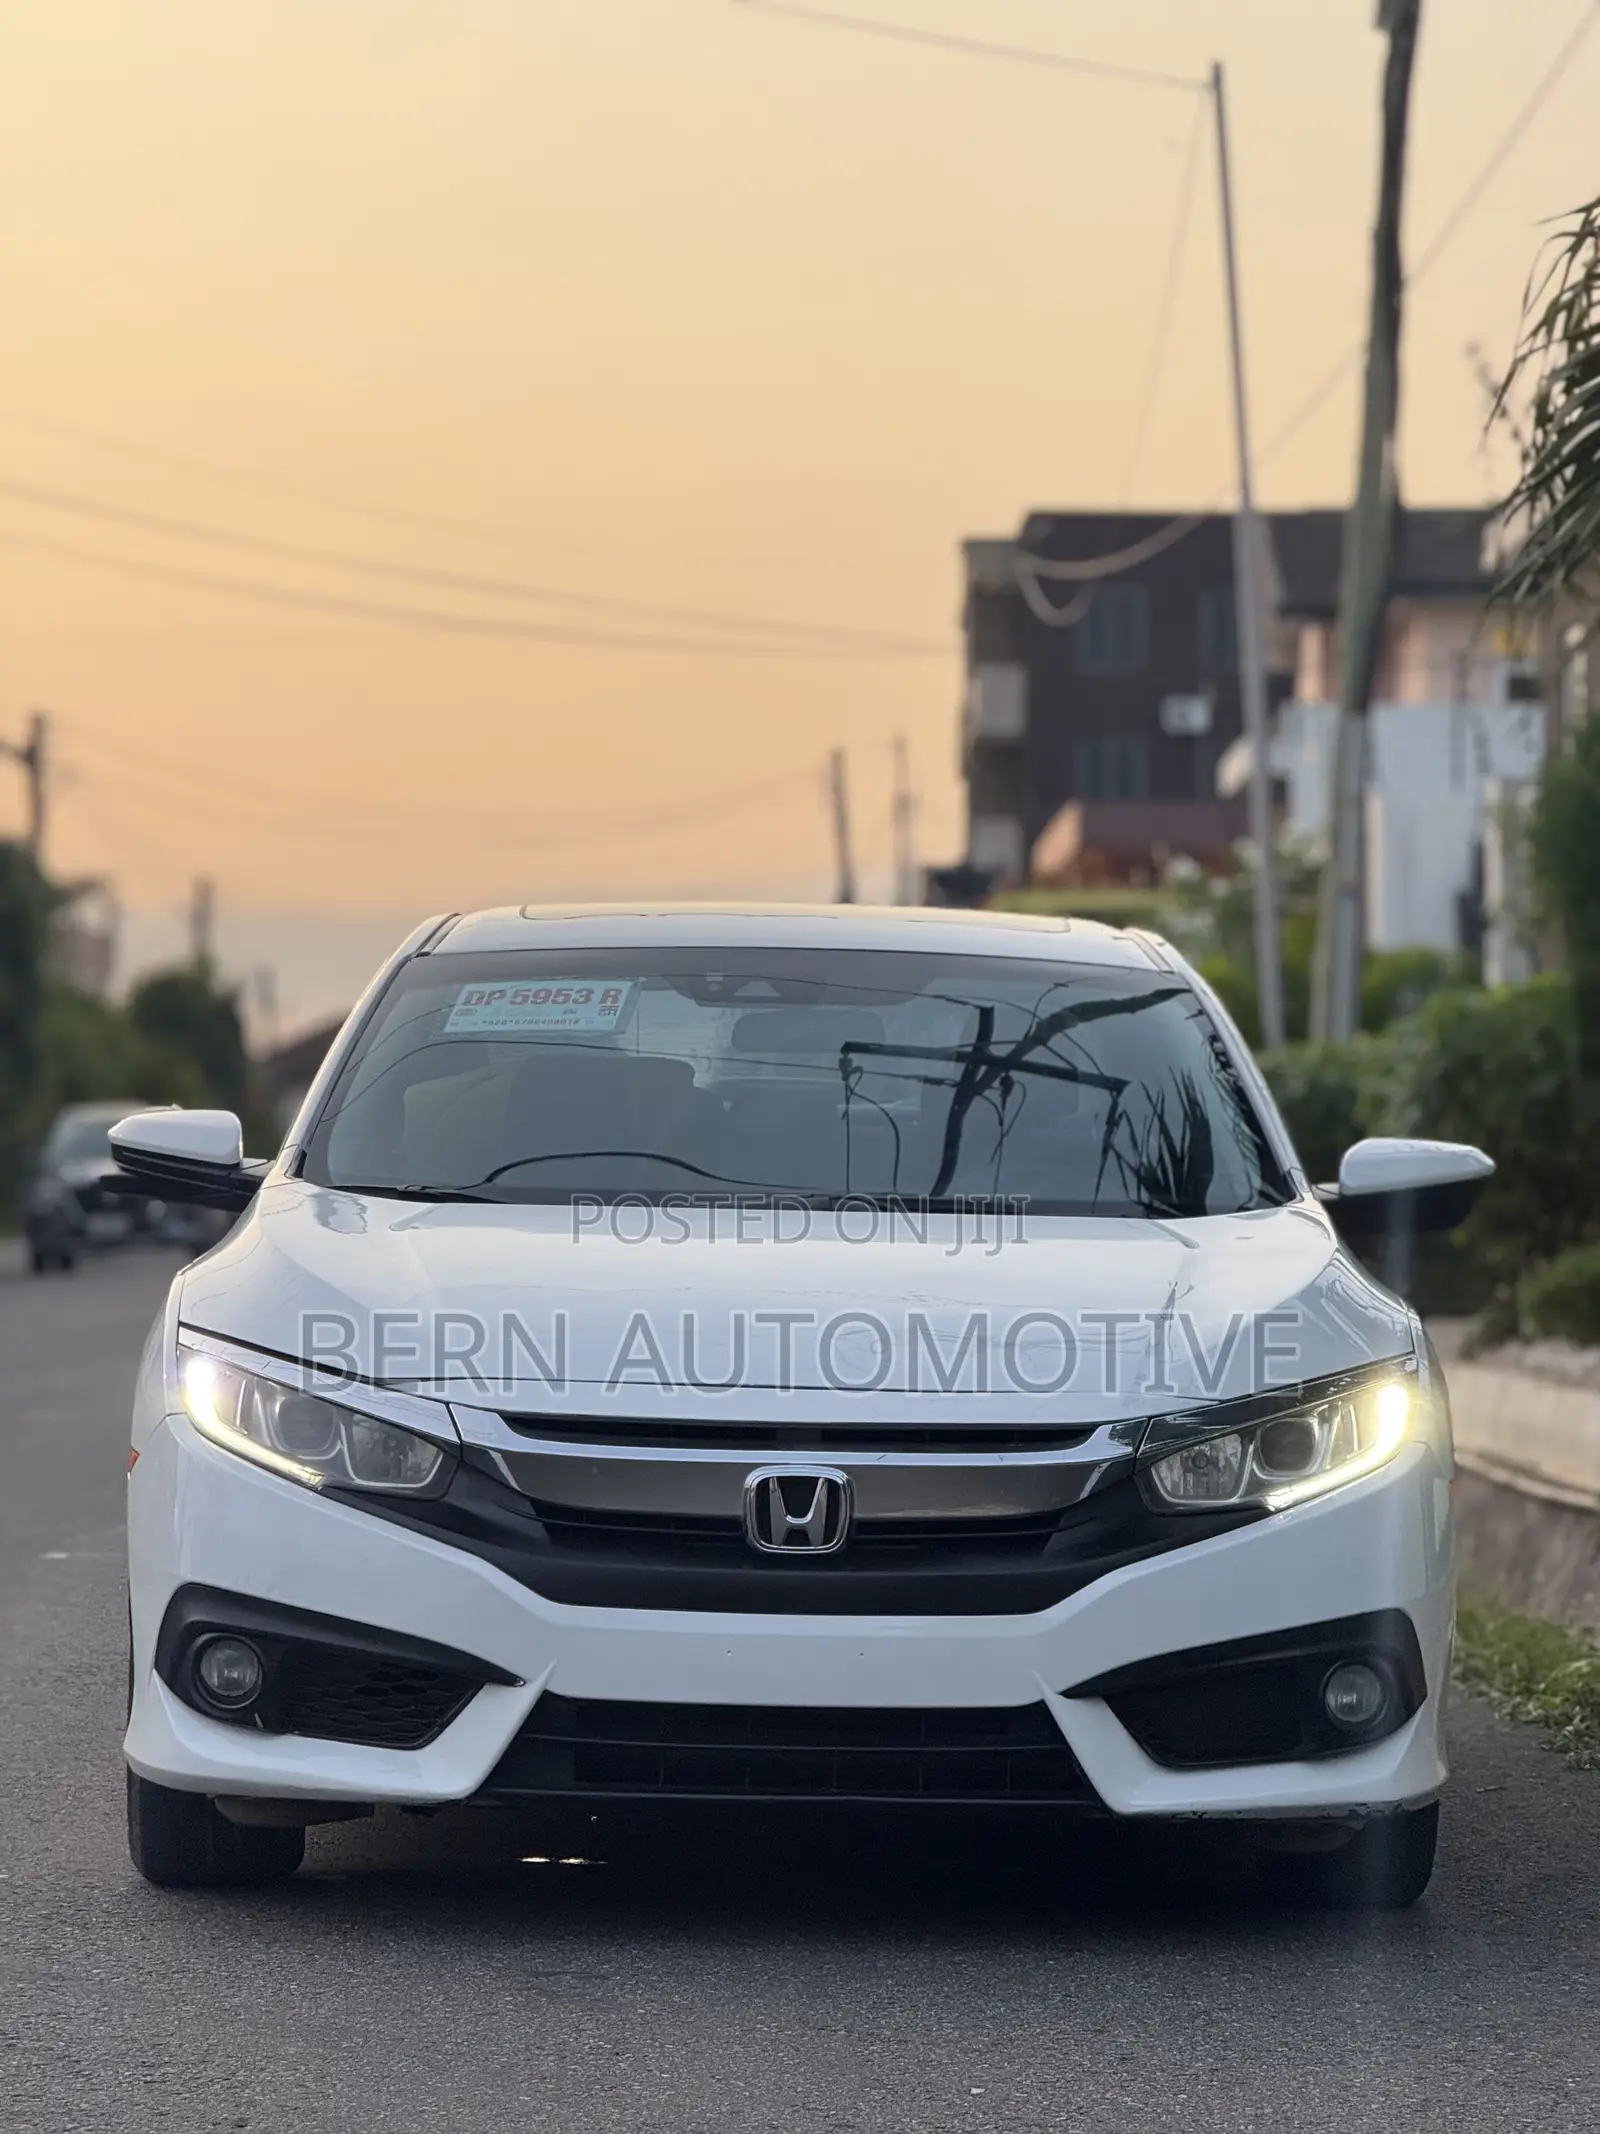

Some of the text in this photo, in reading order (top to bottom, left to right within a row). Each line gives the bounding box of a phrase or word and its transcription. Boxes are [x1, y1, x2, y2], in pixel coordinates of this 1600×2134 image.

[462, 988, 622, 1006] DP 5953 R
